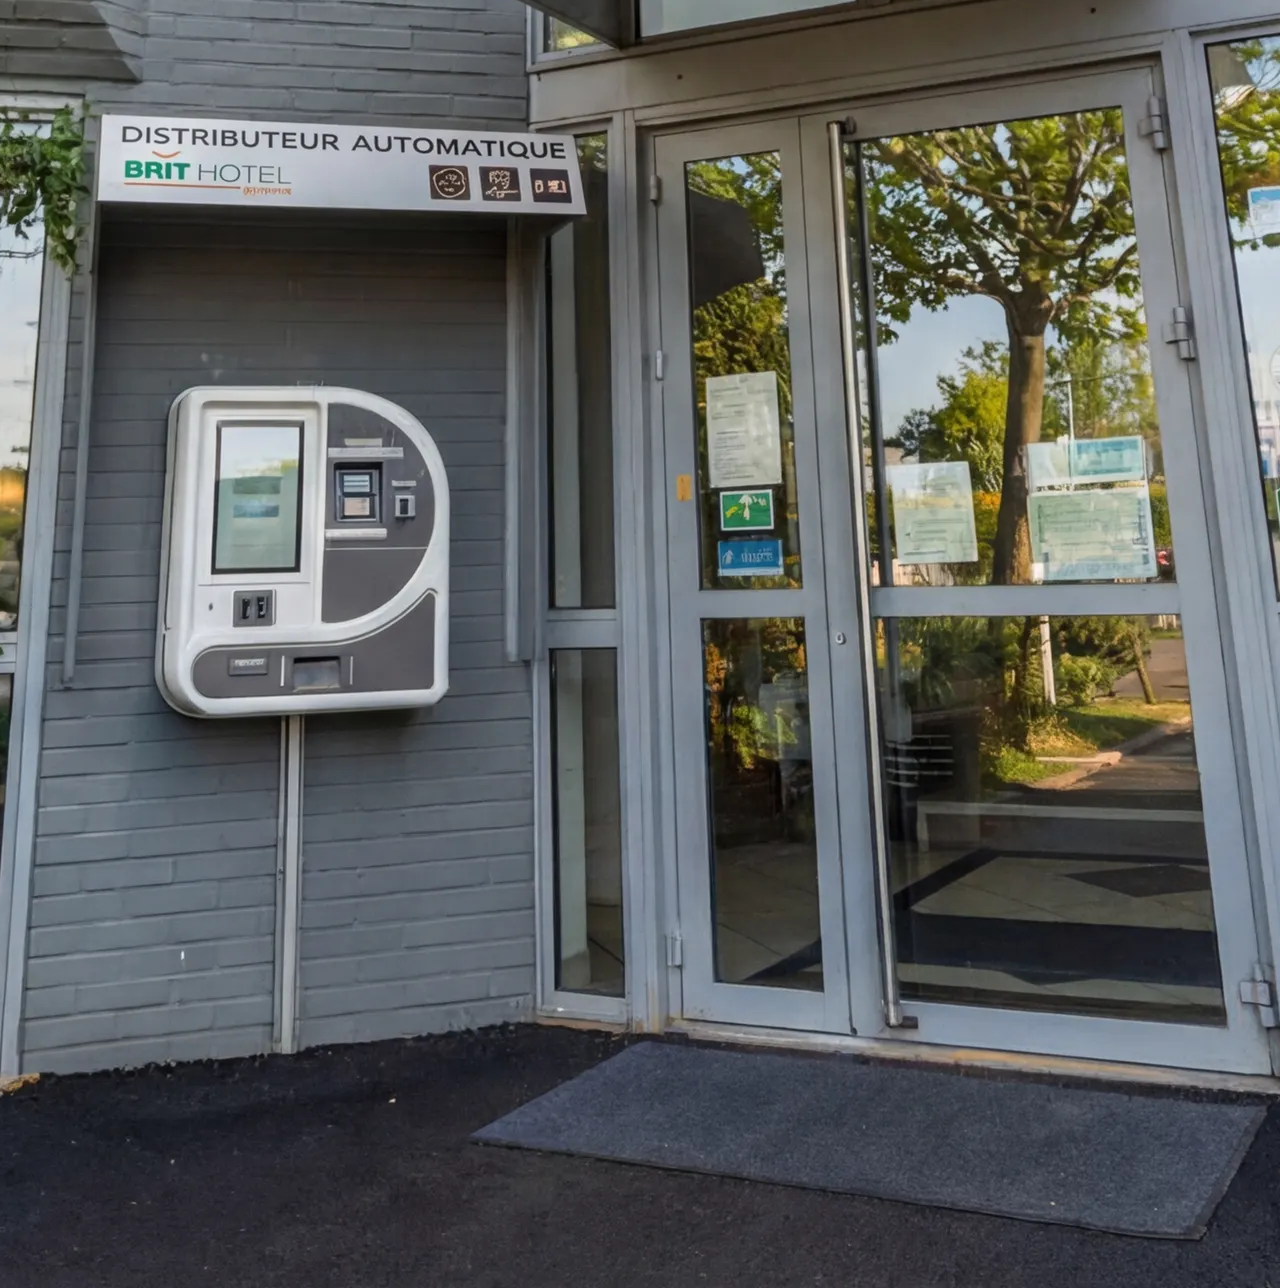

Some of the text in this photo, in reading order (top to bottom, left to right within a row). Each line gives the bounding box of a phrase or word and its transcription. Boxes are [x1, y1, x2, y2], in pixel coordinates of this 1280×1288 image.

[122, 125, 566, 159] DISTRIBUTEUR AUTOMATIQUE
[124, 160, 292, 184] BRIT HOTEL
